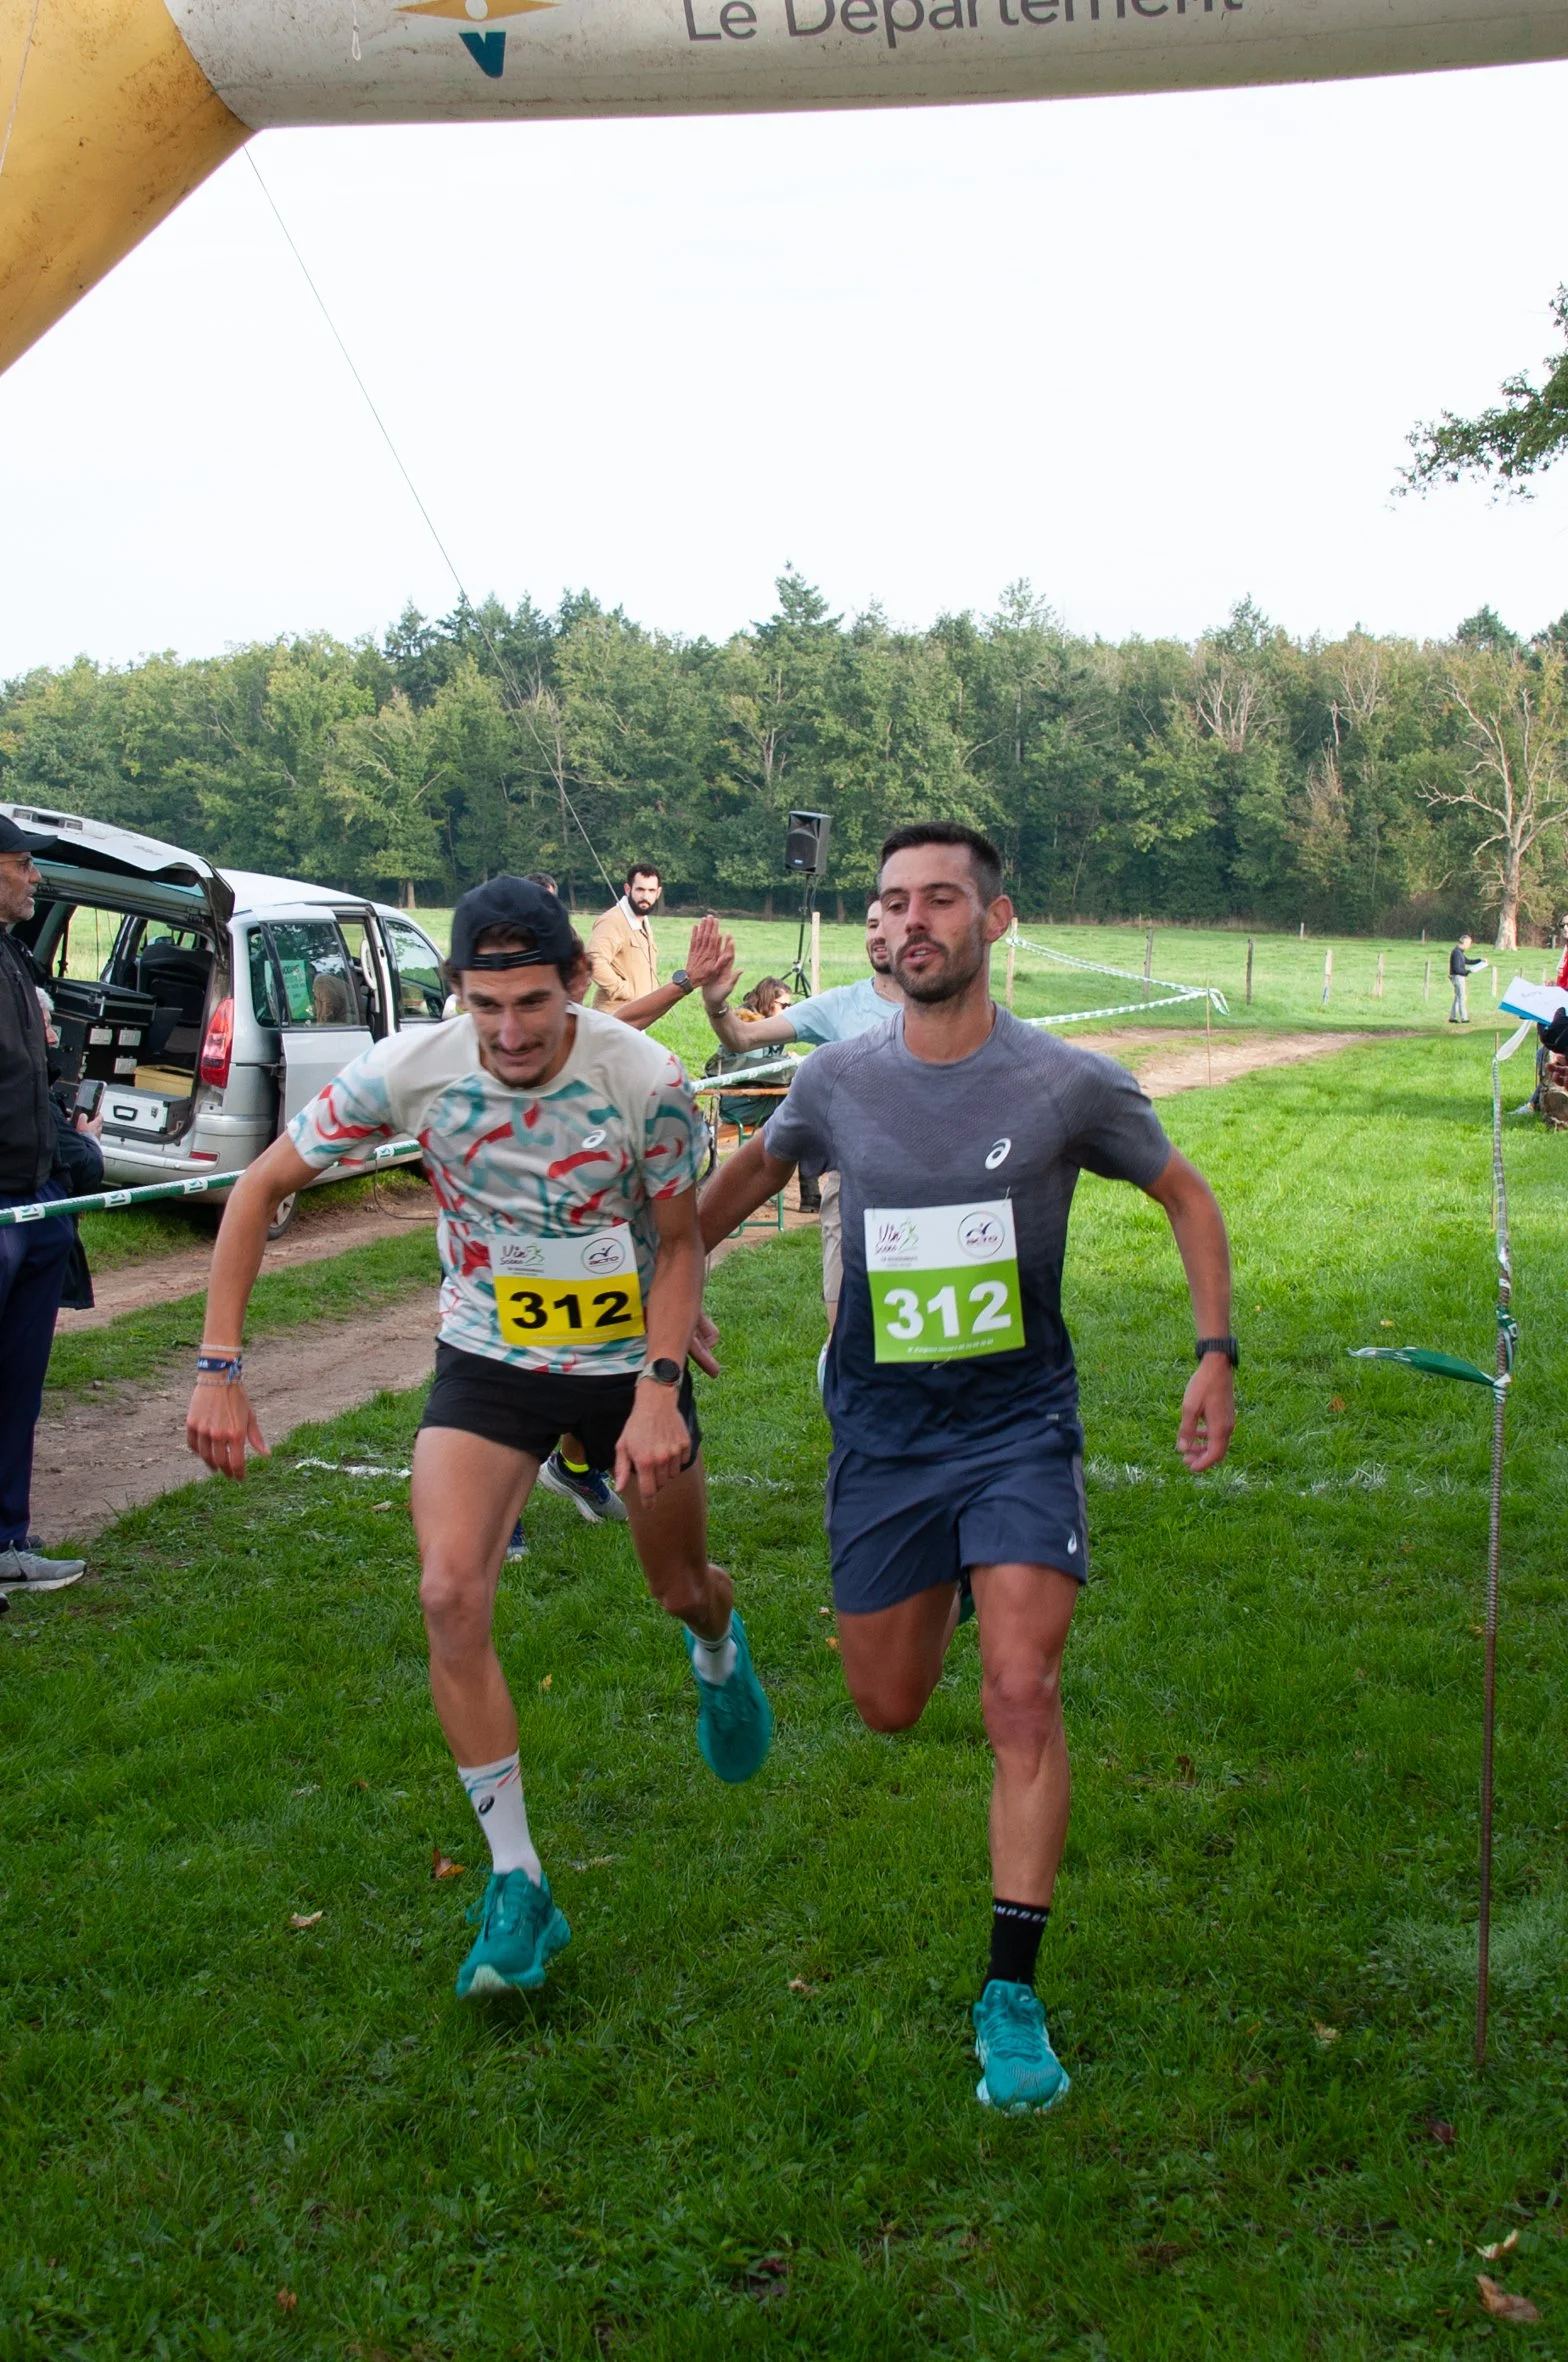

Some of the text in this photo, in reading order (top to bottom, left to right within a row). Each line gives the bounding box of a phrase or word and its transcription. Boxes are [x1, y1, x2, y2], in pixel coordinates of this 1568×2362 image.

[684, 0, 758, 41] Le
[509, 1290, 632, 1330] 312
[883, 1279, 1012, 1340] 312
